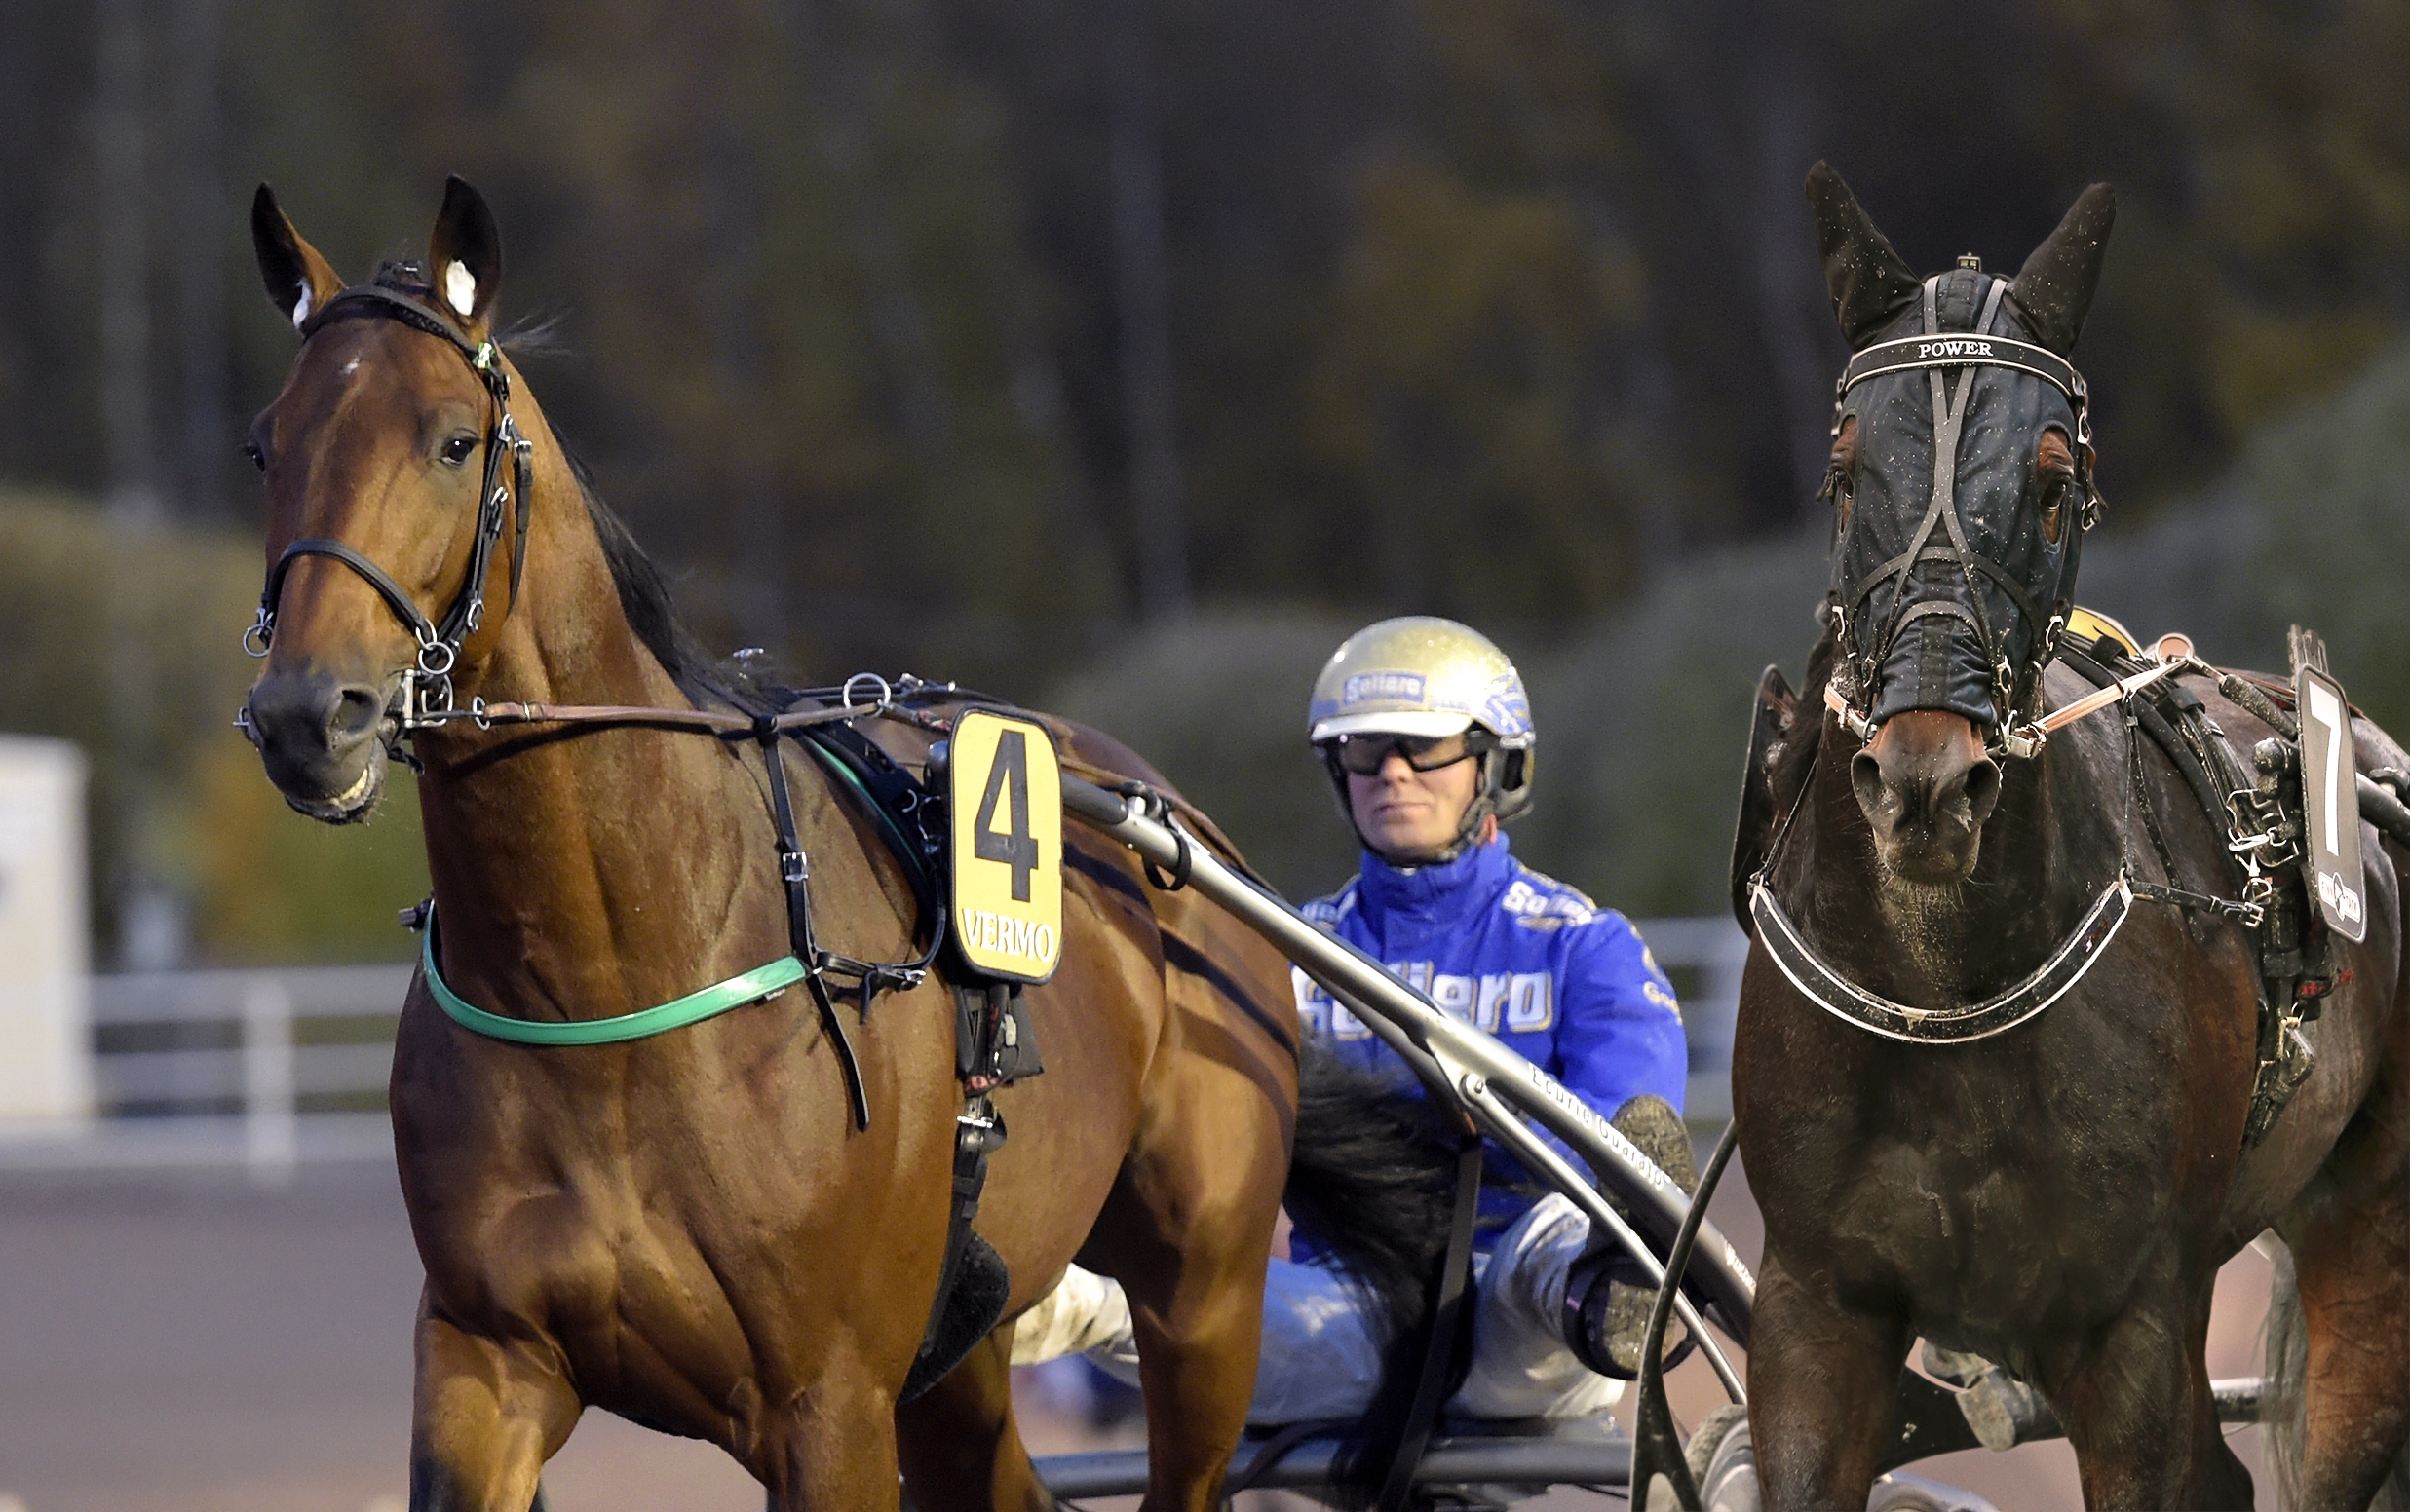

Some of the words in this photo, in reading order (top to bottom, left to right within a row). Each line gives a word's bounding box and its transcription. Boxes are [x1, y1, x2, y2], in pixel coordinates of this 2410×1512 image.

[1919, 341, 1993, 359] POWER
[2308, 679, 2343, 857] 7
[975, 728, 1038, 903] 4
[961, 907, 1055, 963] VERMO
[1528, 1062, 1592, 1129] Ecurie
